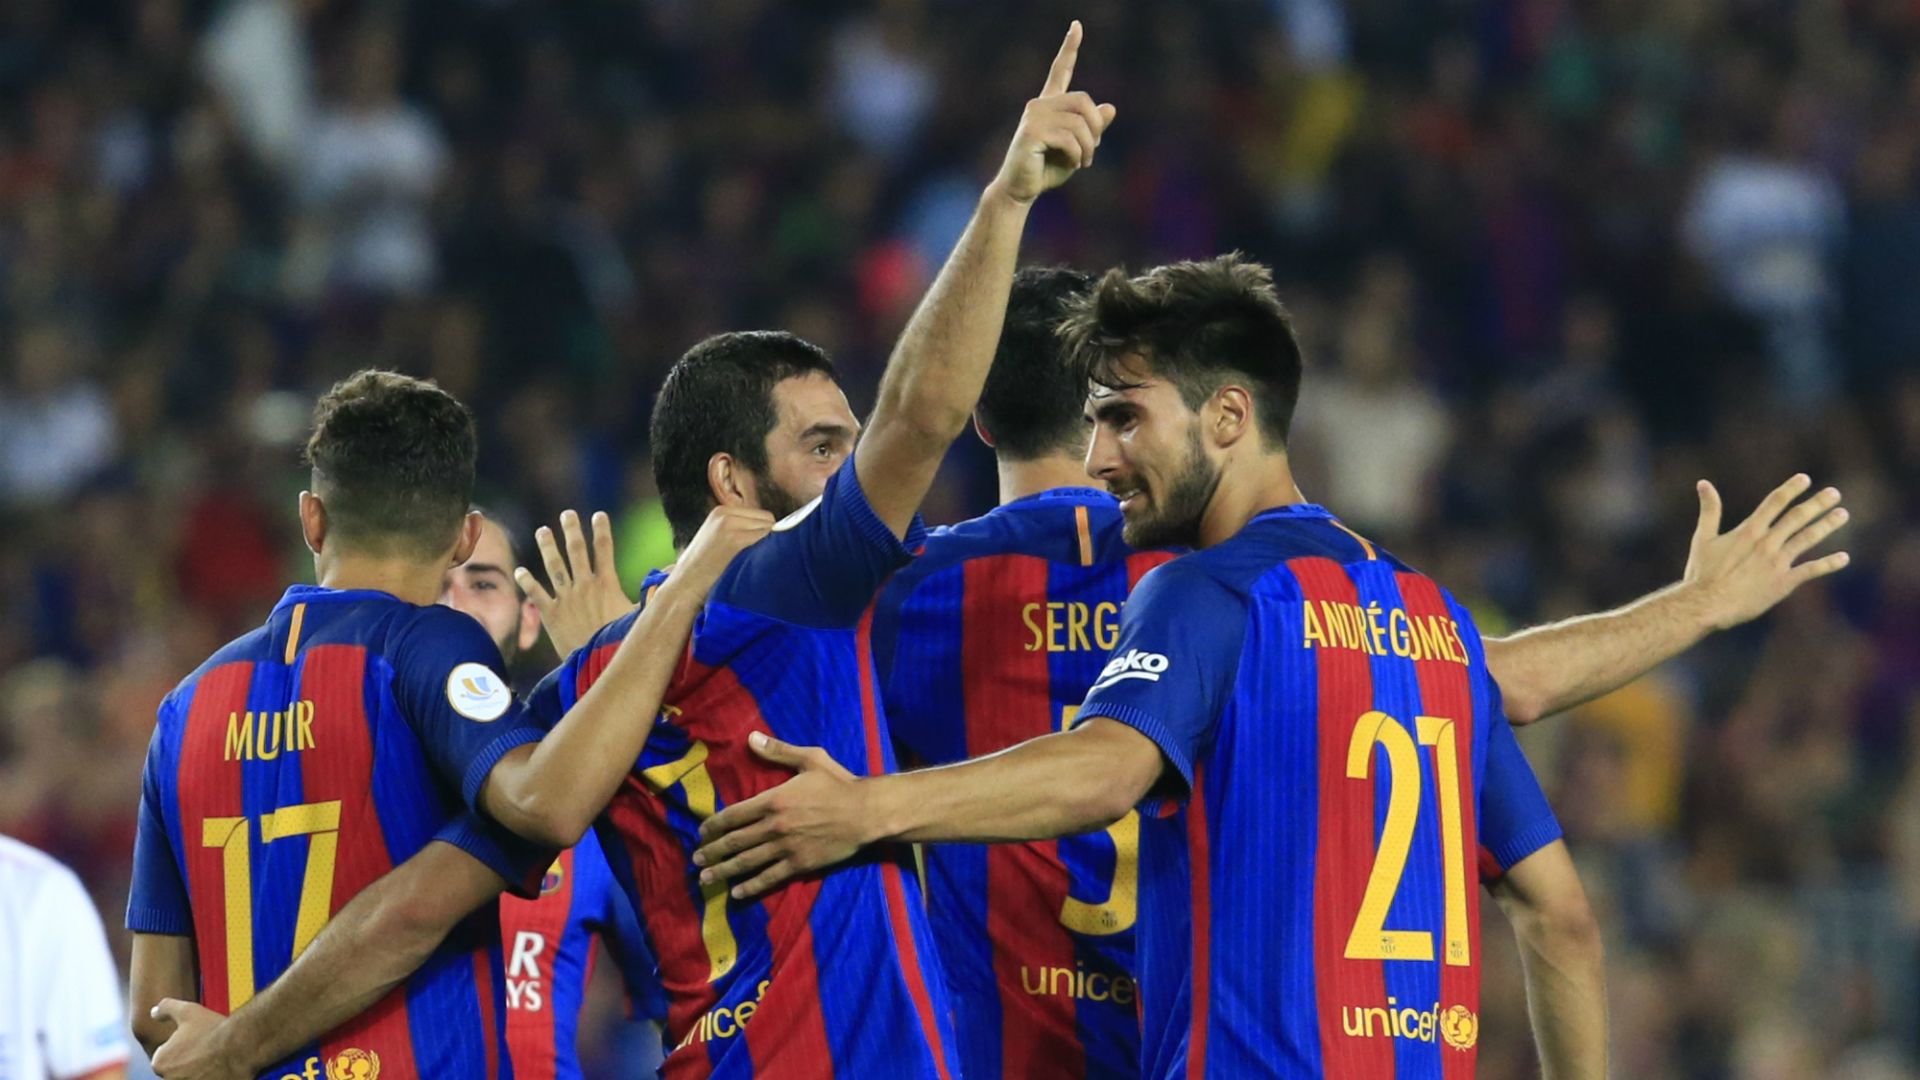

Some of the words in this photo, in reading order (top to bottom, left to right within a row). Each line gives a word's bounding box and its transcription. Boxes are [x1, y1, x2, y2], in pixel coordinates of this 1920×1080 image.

[1022, 601, 1126, 652] SERG
[1303, 599, 1388, 656] ANDRÉ
[1389, 607, 1470, 667] GOMES
[1097, 648, 1169, 680] eko
[1343, 710, 1471, 967] 21
[202, 800, 342, 1014] 17
[1021, 960, 1137, 1004] unice
[1342, 996, 1440, 1044] unicef
